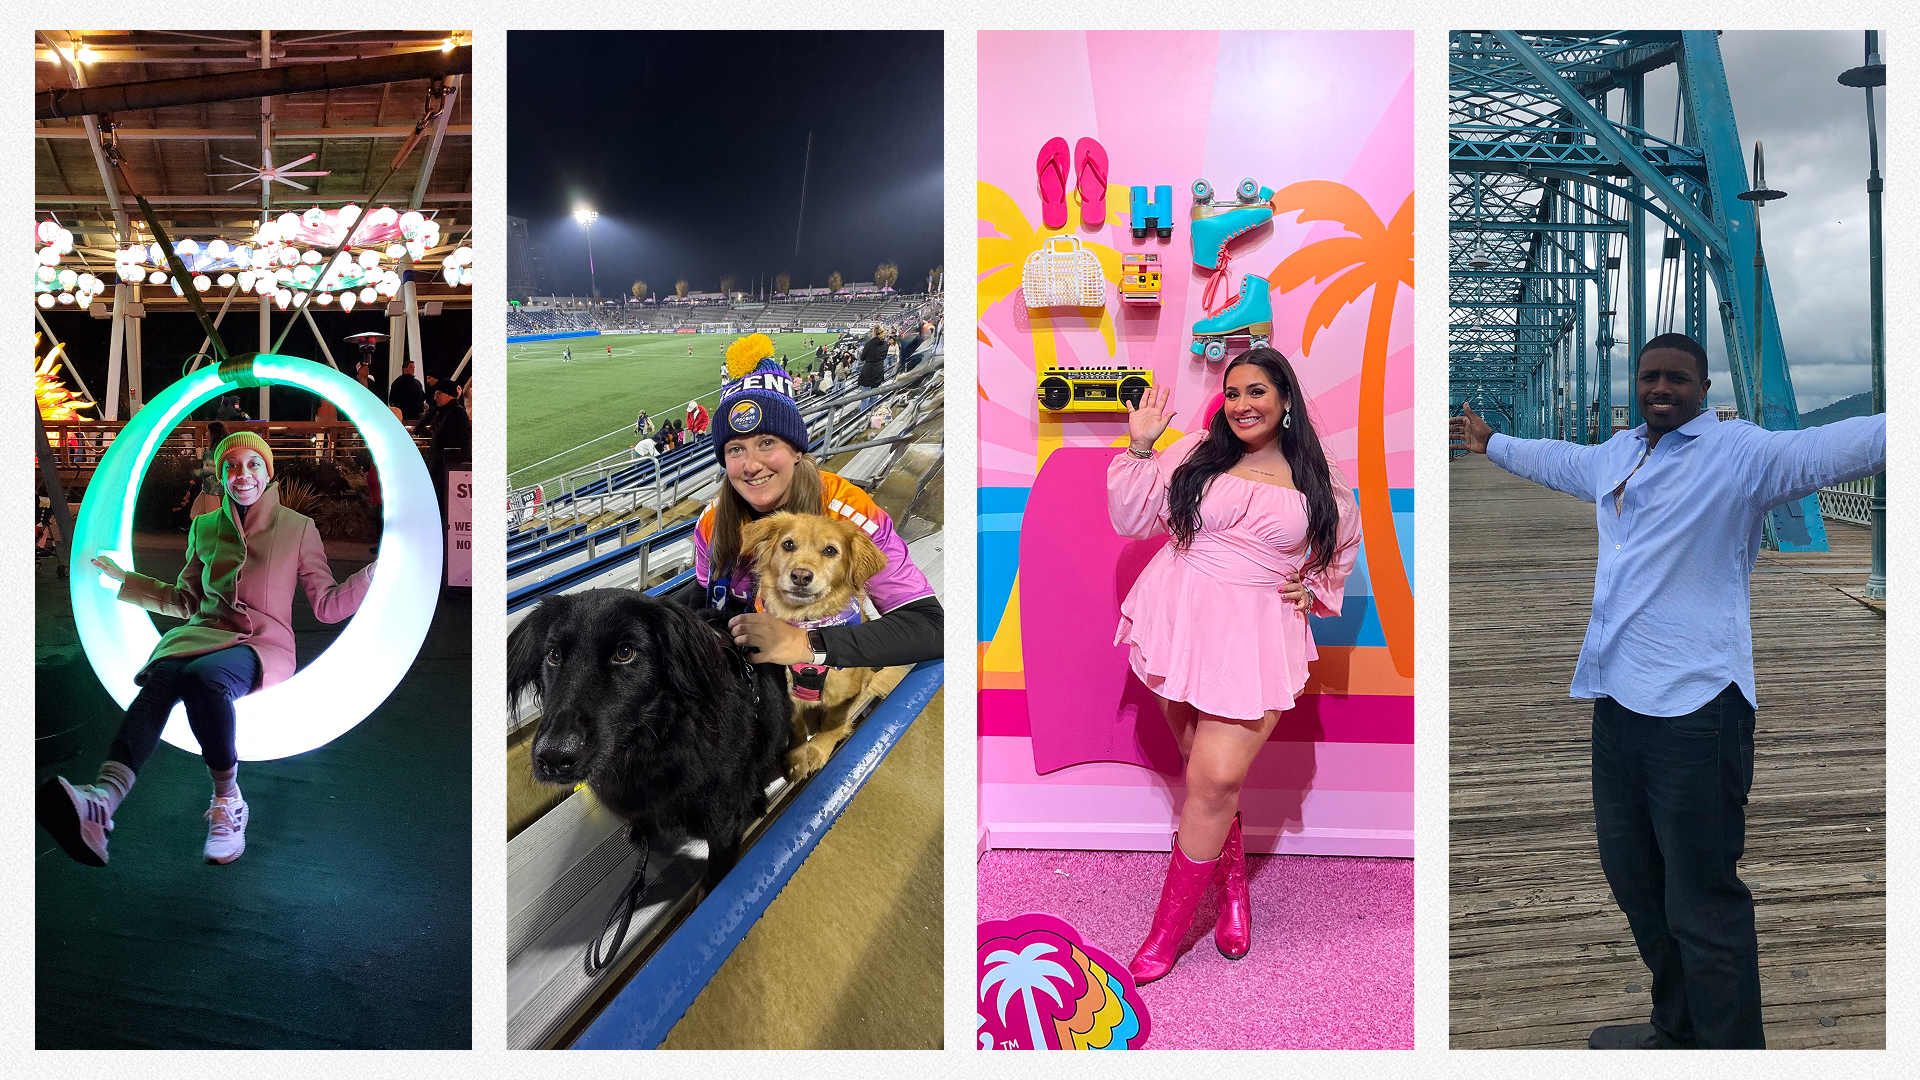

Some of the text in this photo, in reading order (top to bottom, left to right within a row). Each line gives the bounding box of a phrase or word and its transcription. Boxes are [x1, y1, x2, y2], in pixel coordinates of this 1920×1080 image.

[720, 374, 794, 402] CENT
[523, 493, 534, 502] 103
[455, 521, 472, 531] WE
[456, 540, 471, 550] NO
[1000, 1039, 1019, 1050] TM
